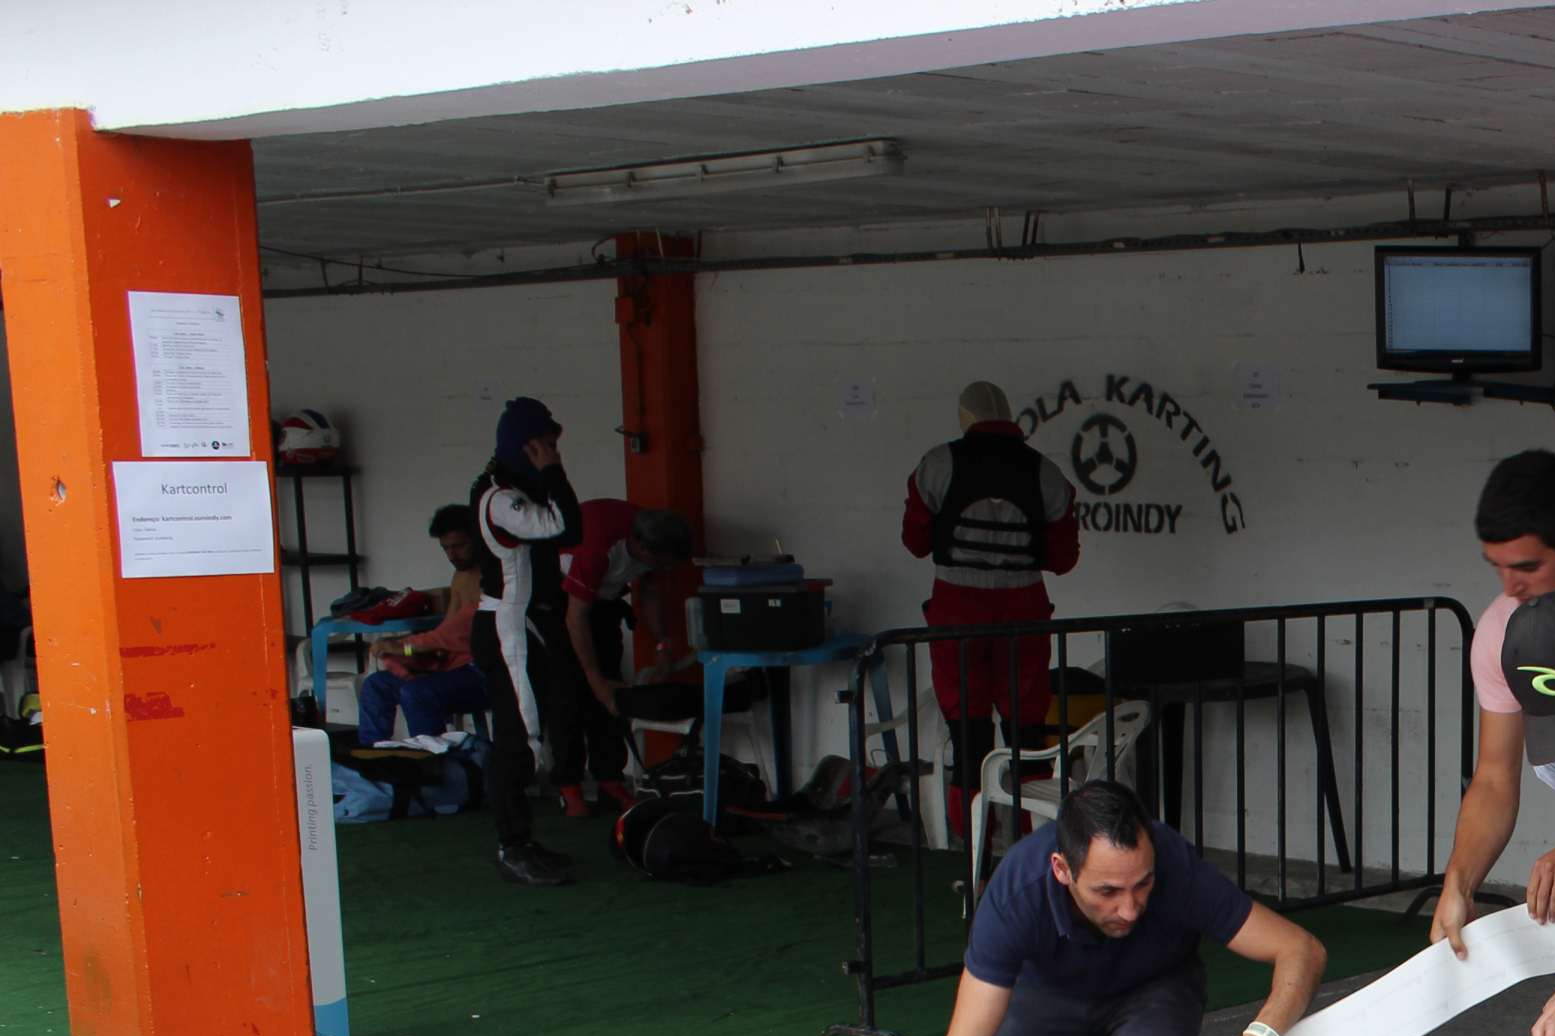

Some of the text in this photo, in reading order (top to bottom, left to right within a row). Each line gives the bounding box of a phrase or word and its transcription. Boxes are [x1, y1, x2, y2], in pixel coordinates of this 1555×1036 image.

[1105, 373, 1246, 534] KARTING
[161, 483, 228, 496] Kartcontrol
[307, 809, 318, 851] Printing
